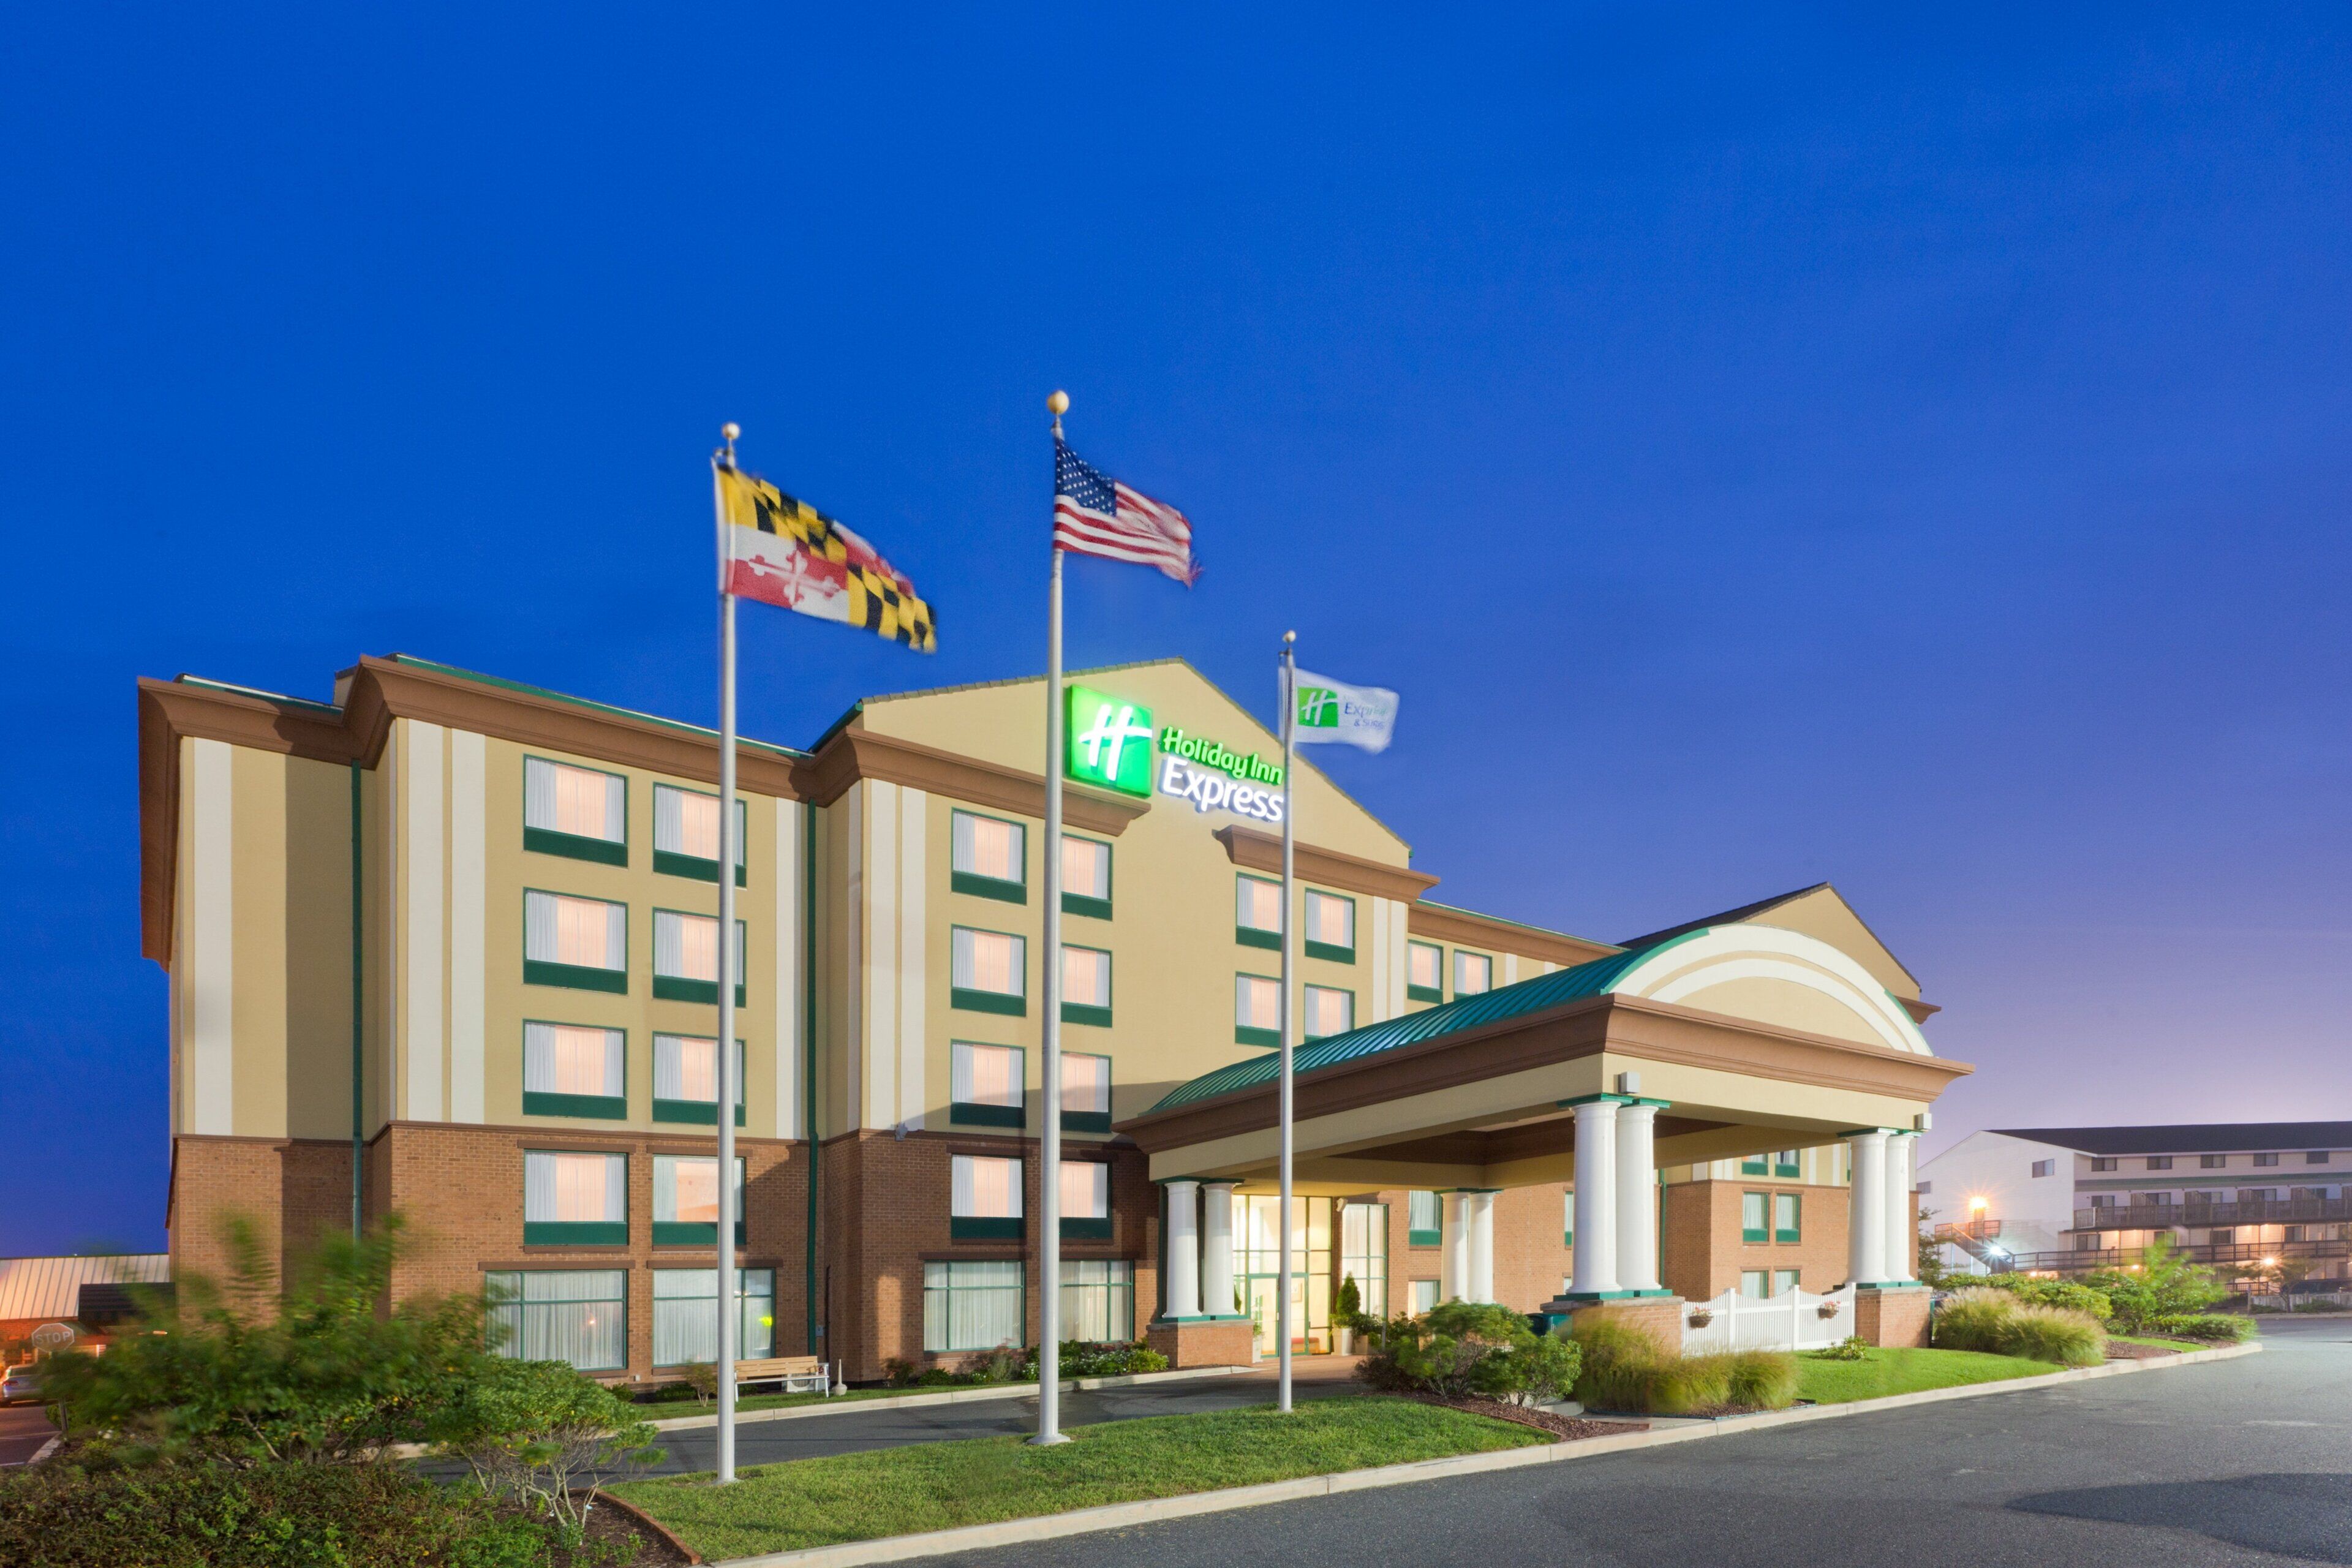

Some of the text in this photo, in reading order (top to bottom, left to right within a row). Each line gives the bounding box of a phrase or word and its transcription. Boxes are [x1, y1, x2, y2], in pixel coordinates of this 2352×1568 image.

[1163, 726, 1283, 785] Holiday Inn
[1163, 755, 1284, 821] Express
[35, 1332, 71, 1344] STOP
